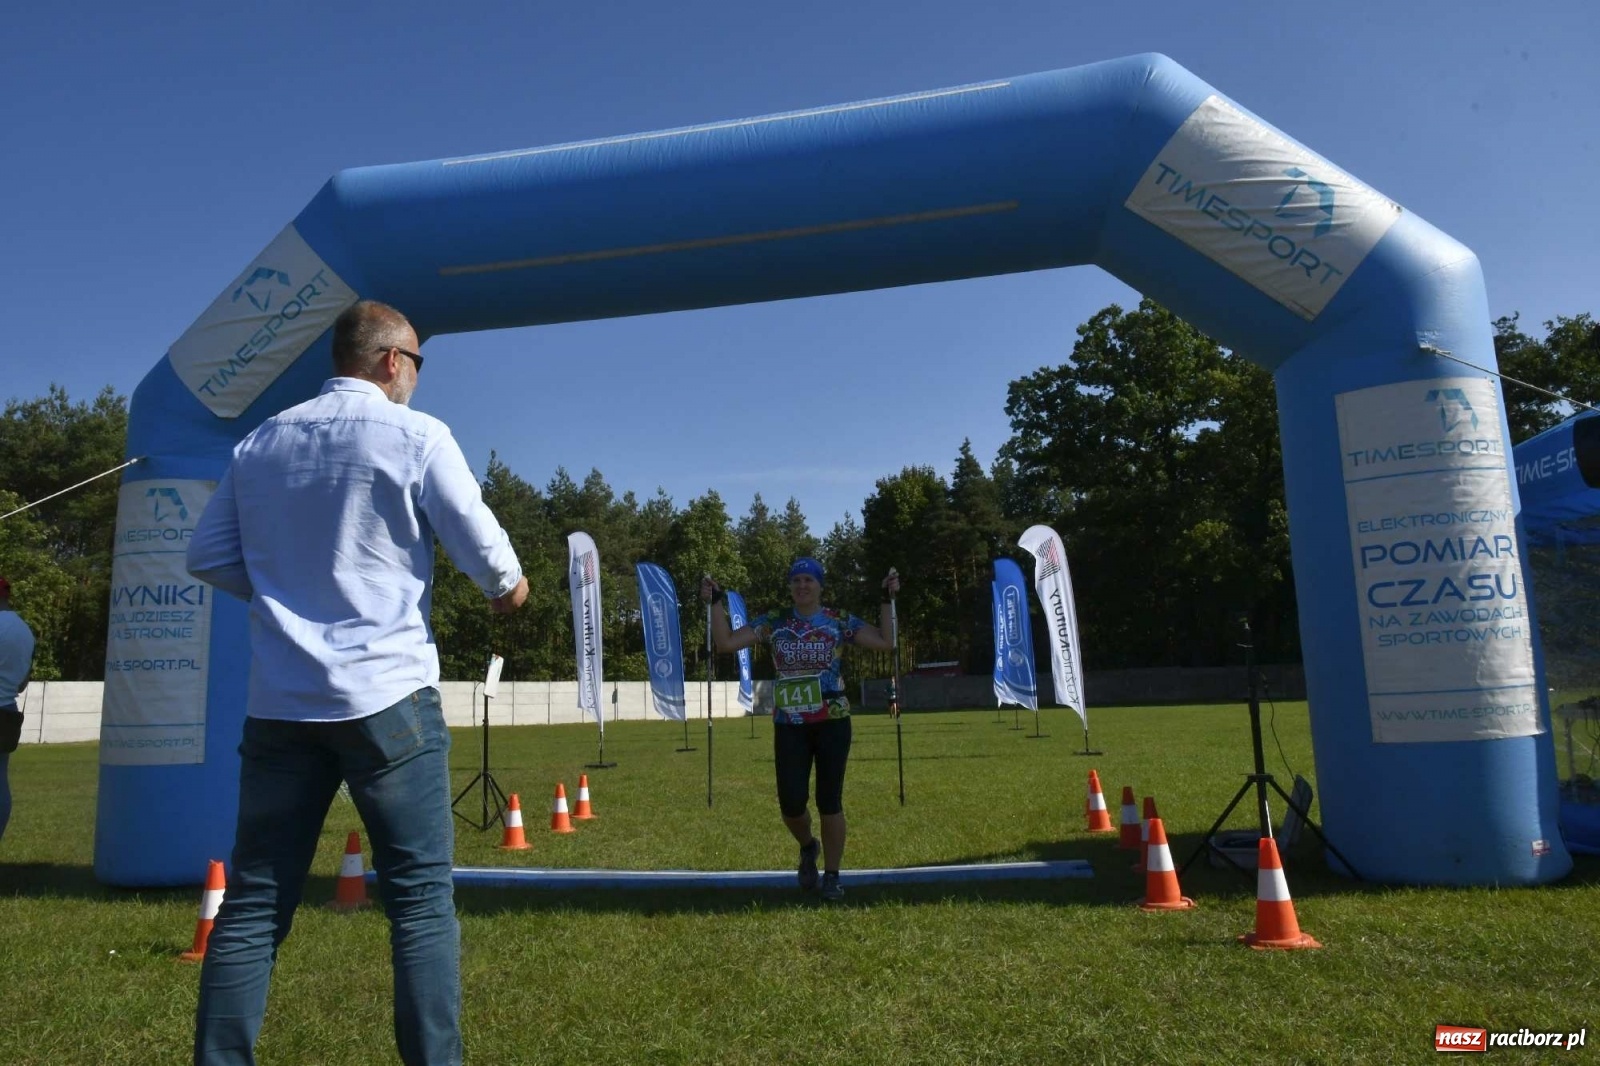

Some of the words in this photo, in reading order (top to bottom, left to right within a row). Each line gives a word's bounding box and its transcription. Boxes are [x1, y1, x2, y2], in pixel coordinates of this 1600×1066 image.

[1154, 162, 1343, 285] TIMESPORT
[198, 268, 331, 398] TIMESPORT
[1347, 438, 1500, 467] TIMESPORT
[1357, 509, 1509, 534] ELEKTRONICZNY
[1360, 534, 1515, 569] POMIAR
[1367, 573, 1518, 609] CZASU
[1369, 614, 1402, 630] NA
[1409, 606, 1522, 627] ZAWODACH
[775, 638, 825, 654] Kocham
[1378, 626, 1521, 648] SPORTOWYCH
[779, 685, 813, 705] 141
